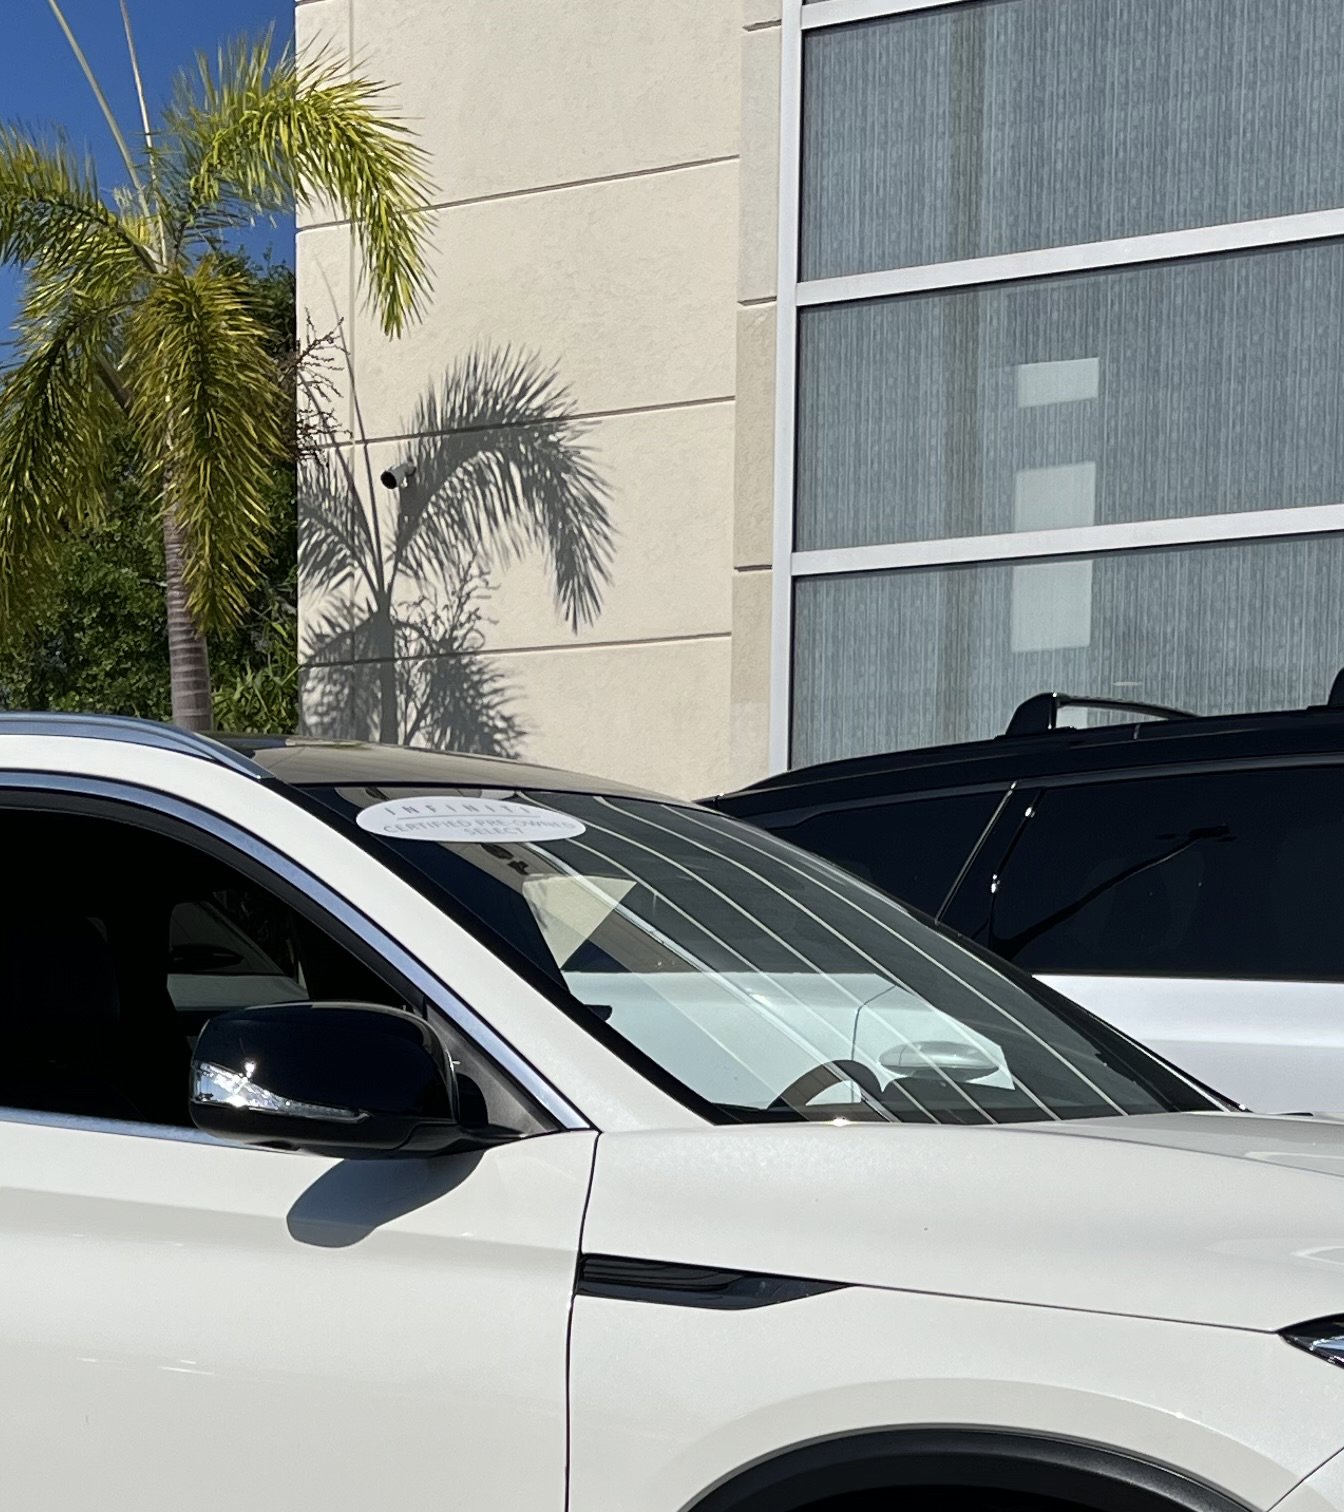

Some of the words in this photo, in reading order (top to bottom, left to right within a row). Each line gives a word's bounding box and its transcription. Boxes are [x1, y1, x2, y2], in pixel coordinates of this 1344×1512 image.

[384, 803, 531, 816] INFINITI
[383, 819, 471, 834] CERTIFIED
[475, 818, 577, 830] PRE-OWNED
[464, 827, 525, 835] SELECT
